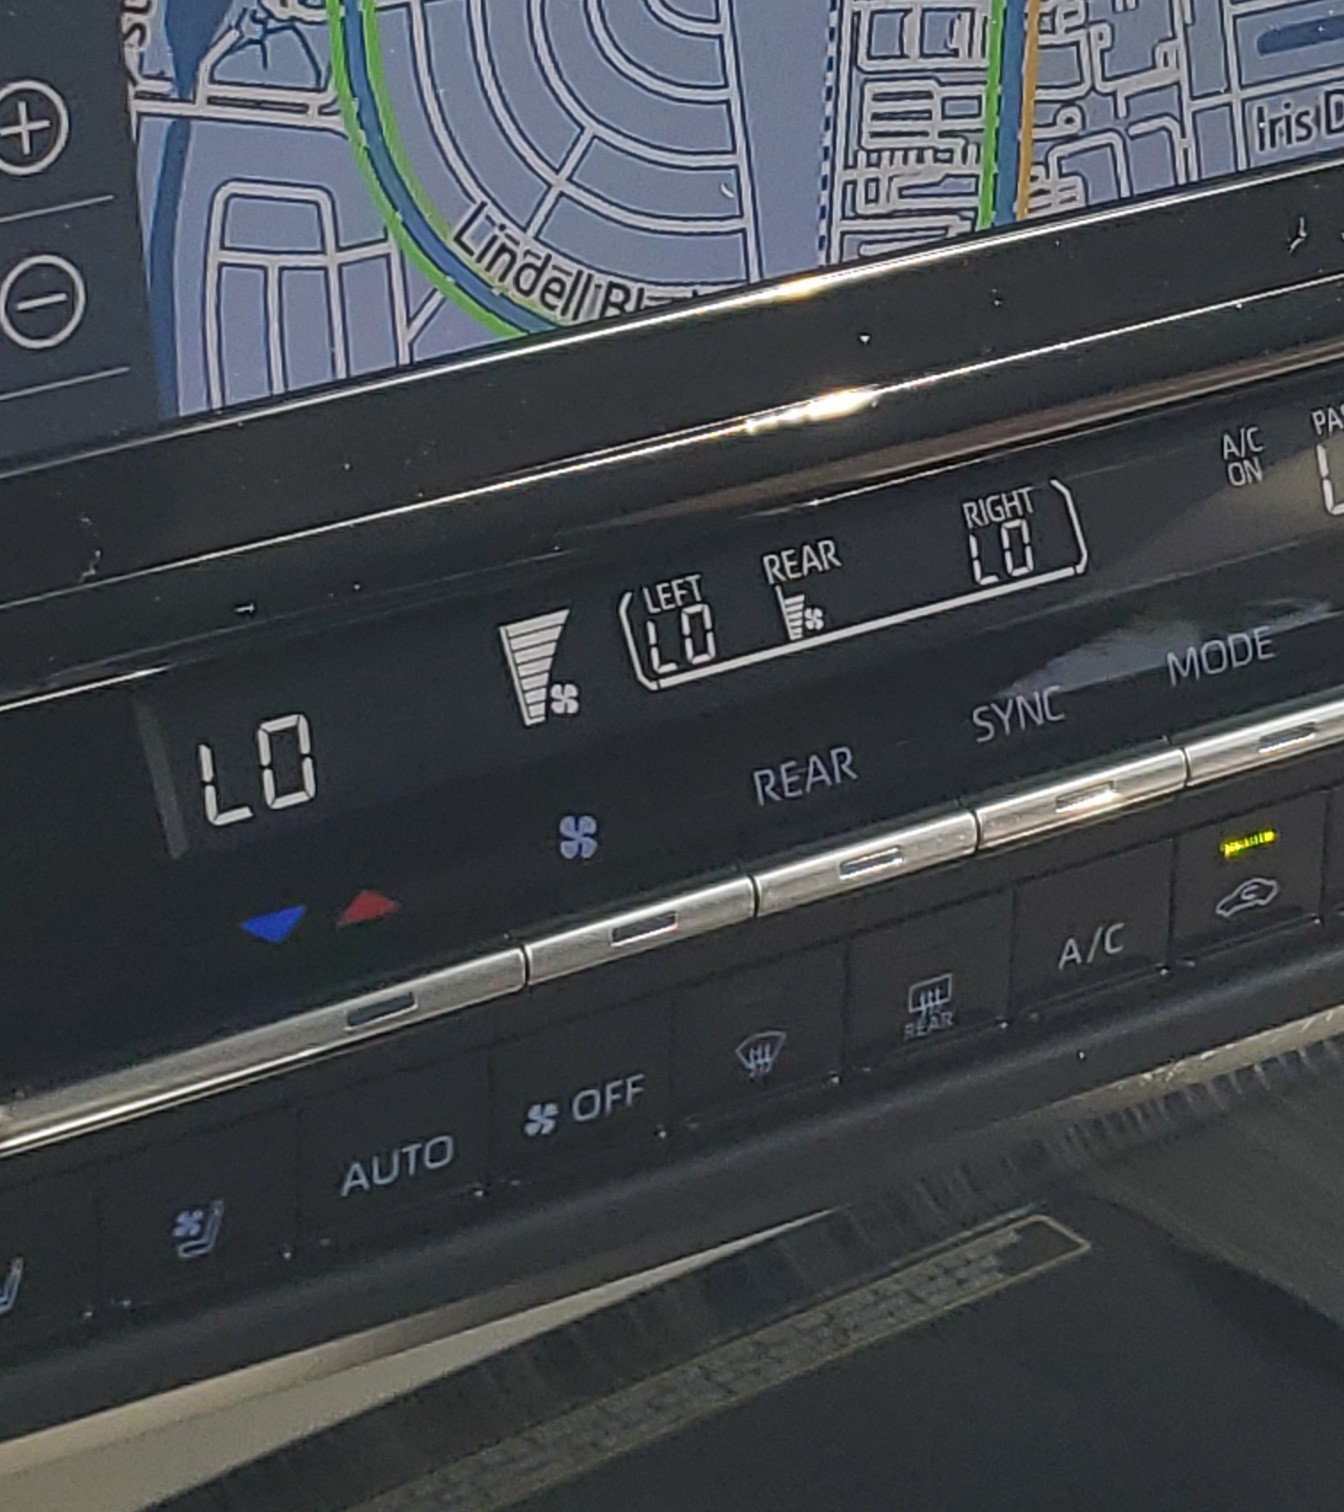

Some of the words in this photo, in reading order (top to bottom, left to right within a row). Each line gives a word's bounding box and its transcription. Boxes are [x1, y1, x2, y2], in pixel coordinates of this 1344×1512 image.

[1256, 102, 1314, 152] Iris
[454, 201, 592, 321] Lindell
[1222, 427, 1265, 461] A/C
[1227, 458, 1263, 487] ON
[963, 488, 1035, 529] RIGHT
[763, 539, 842, 585] REAR
[643, 574, 703, 615] LEFT
[1166, 626, 1276, 687] MODE
[972, 686, 1066, 744] SYNC
[753, 746, 858, 806] REAR
[1058, 922, 1125, 969] A/C
[571, 1075, 646, 1124] OFF
[341, 1135, 455, 1197] AUTO
